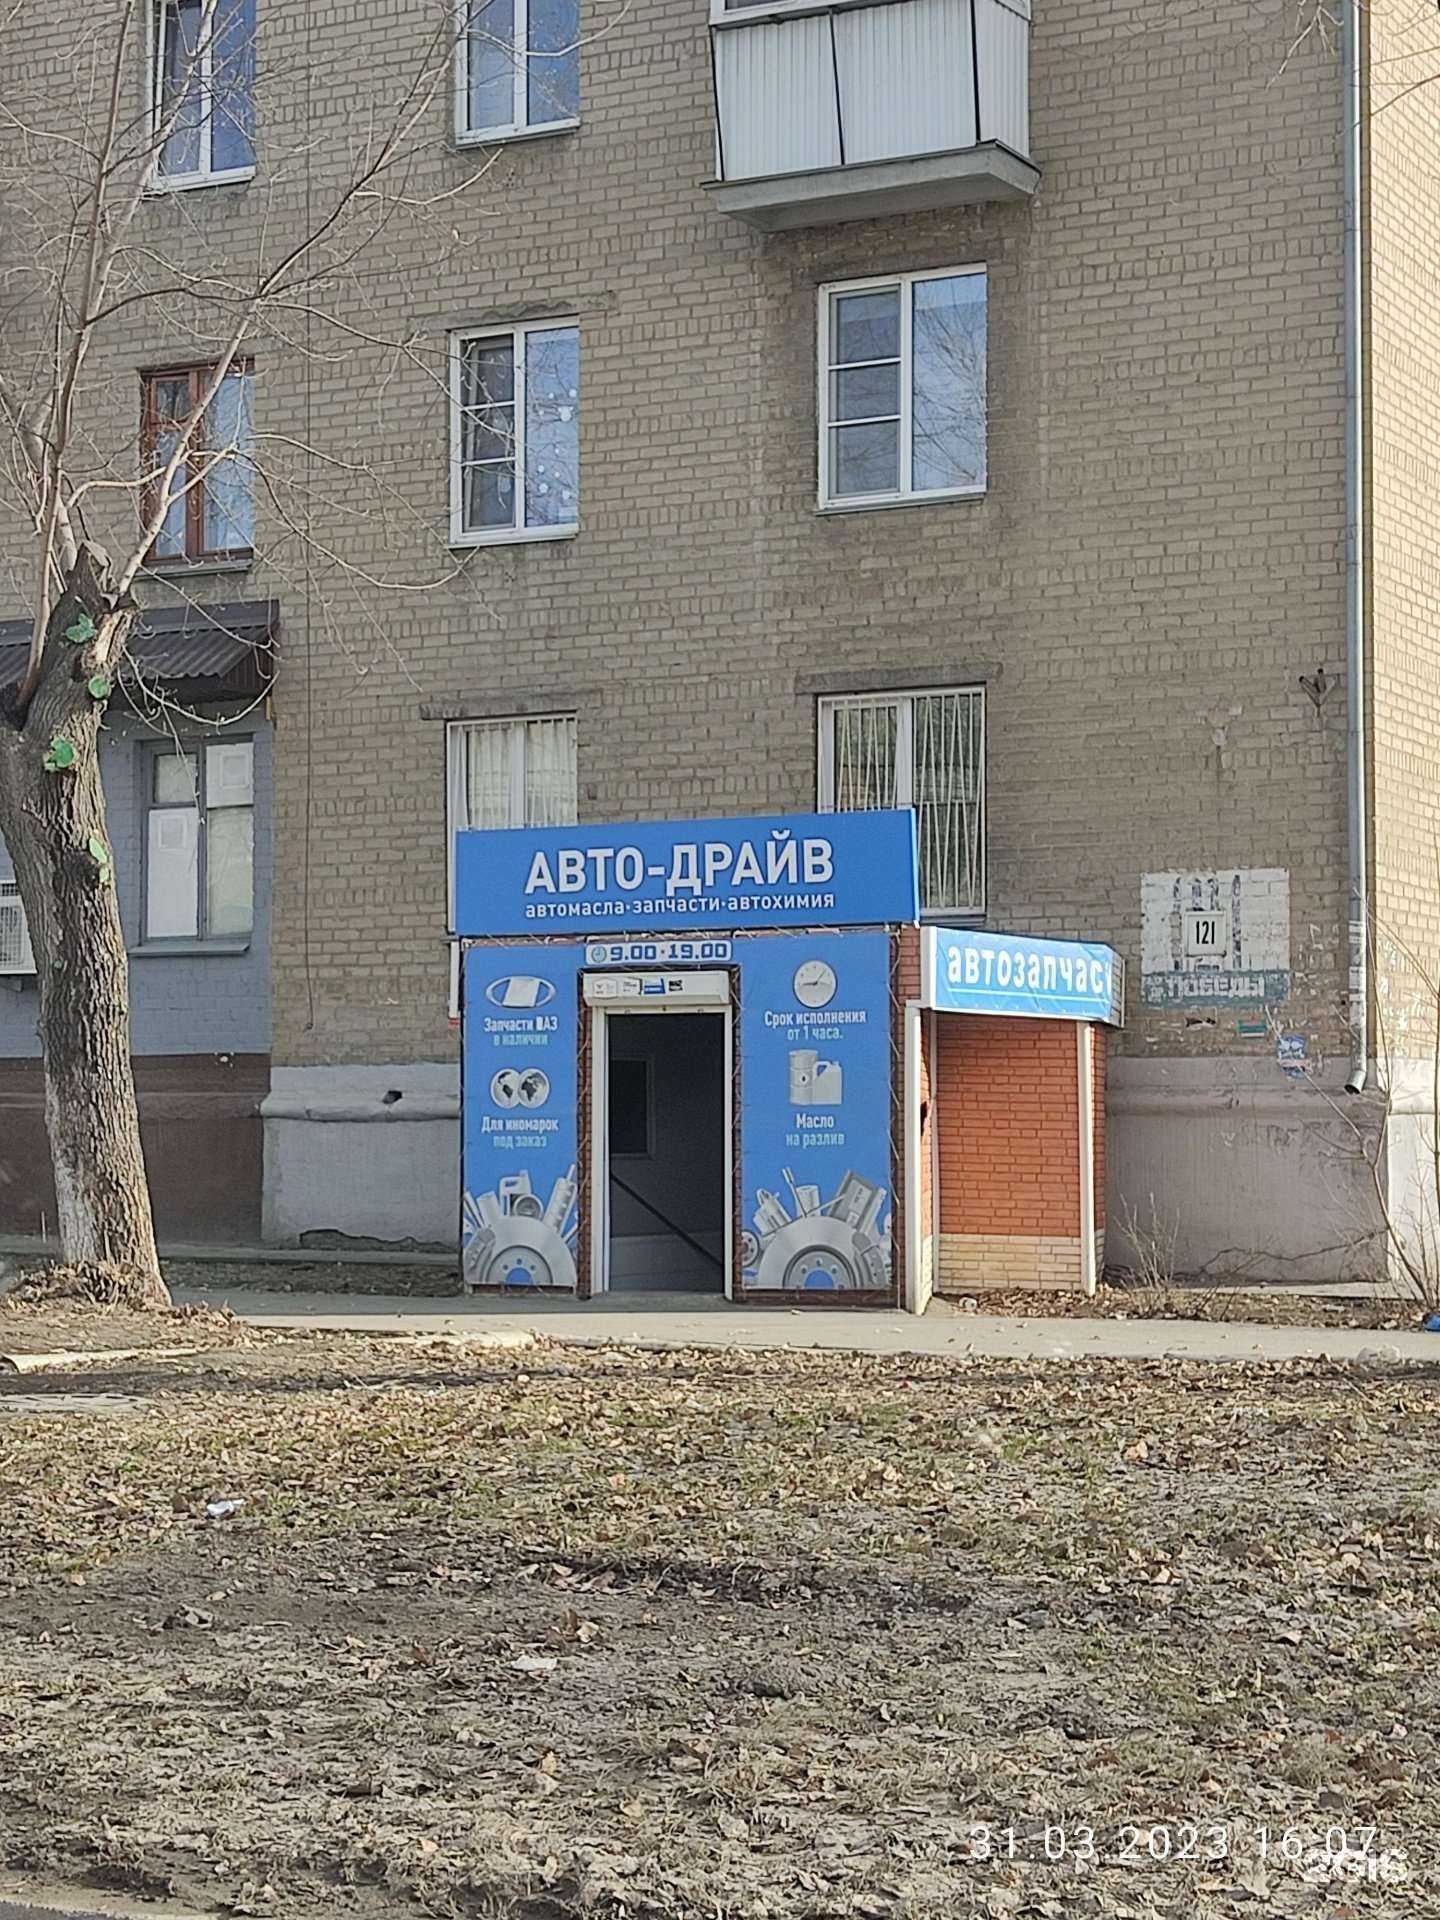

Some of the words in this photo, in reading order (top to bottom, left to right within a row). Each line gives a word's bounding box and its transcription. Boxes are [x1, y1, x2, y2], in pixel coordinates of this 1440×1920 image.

[525, 829, 834, 896] АВТО-ДРАЙВ
[1195, 920, 1216, 945] 121
[484, 1016, 533, 1032] Запчасти
[764, 1010, 794, 1028] Срок
[796, 1010, 866, 1024] исполнения
[493, 1035, 500, 1046] в
[502, 1034, 548, 1046] наличии
[787, 1029, 800, 1040] от
[803, 1026, 809, 1039] 1
[481, 1117, 503, 1133] Для
[505, 1118, 559, 1133] иномарок
[796, 1113, 834, 1128] Масло
[493, 1136, 513, 1148] под
[515, 1136, 547, 1147] заказ
[785, 1134, 800, 1146] на
[802, 1132, 845, 1148] разлив
